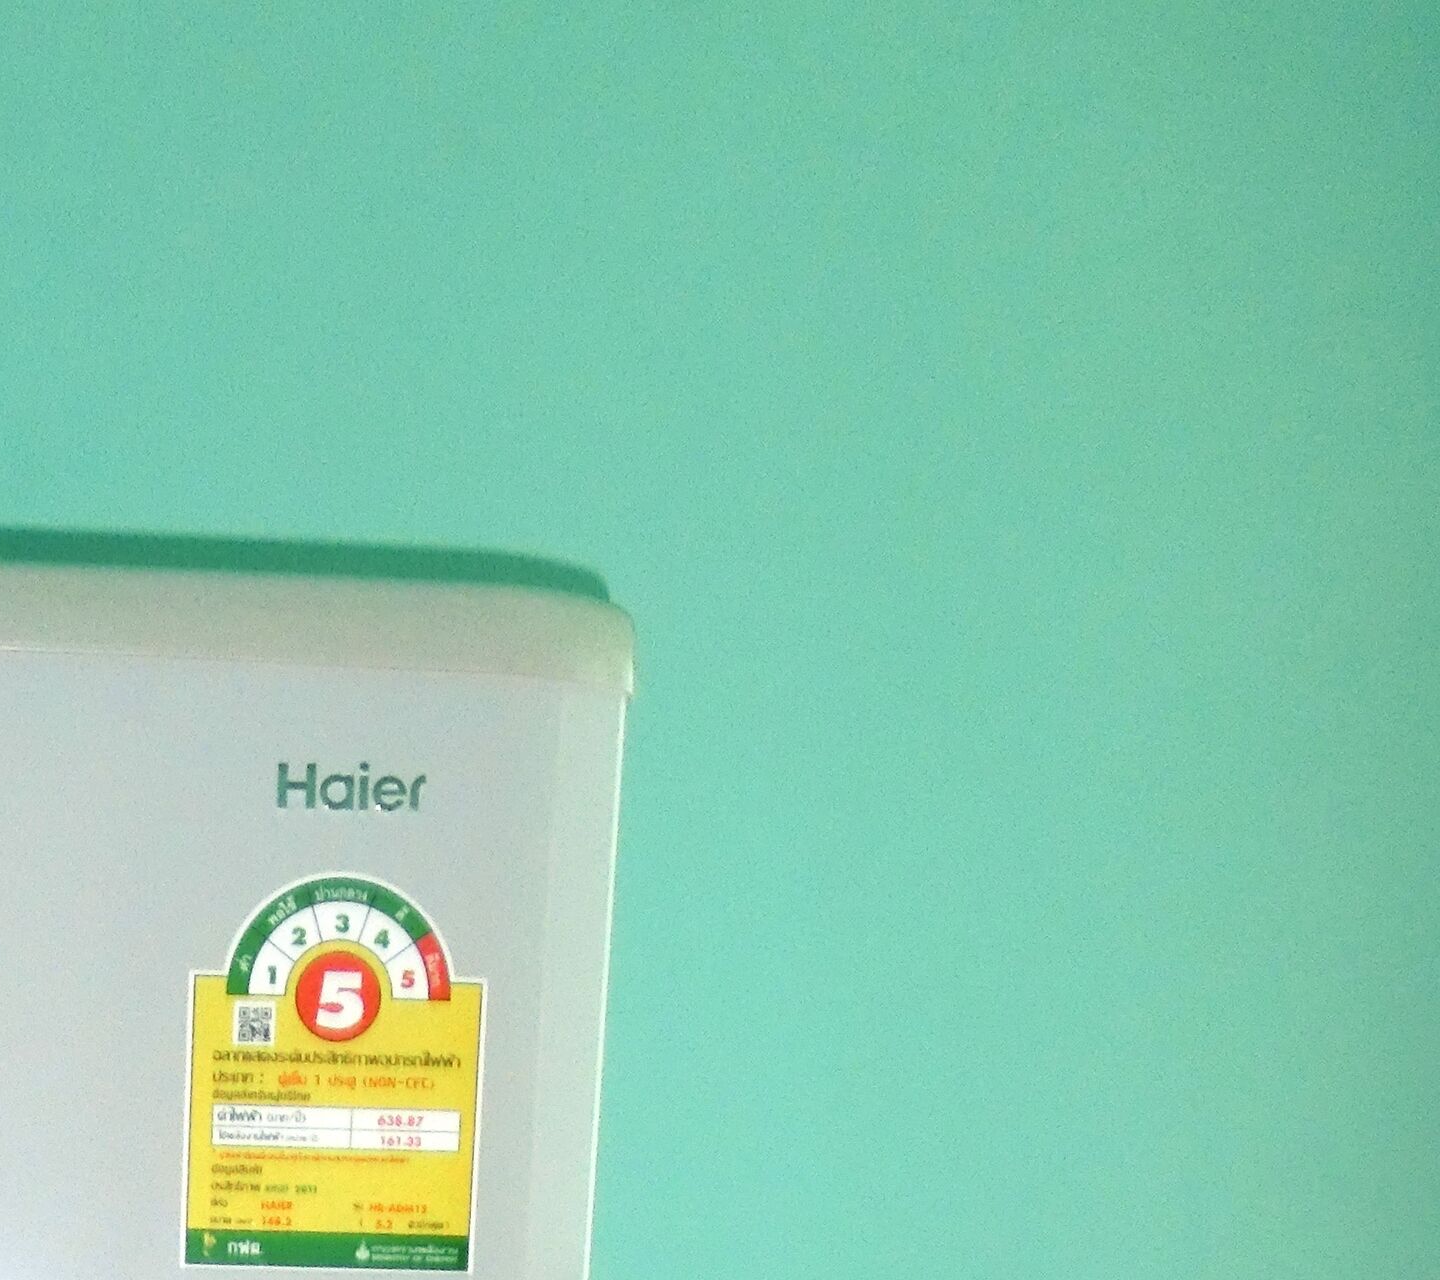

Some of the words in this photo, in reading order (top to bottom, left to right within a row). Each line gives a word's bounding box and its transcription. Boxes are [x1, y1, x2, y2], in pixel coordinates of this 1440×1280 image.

[277, 760, 427, 811] Haier
[335, 914, 350, 933] 3
[291, 927, 308, 946] 2
[374, 928, 391, 949] 4
[267, 965, 277, 984] 1
[400, 970, 415, 988] 5
[315, 970, 364, 1030] 5
[314, 1074, 320, 1085] 1
[377, 1114, 424, 1127] 638.87
